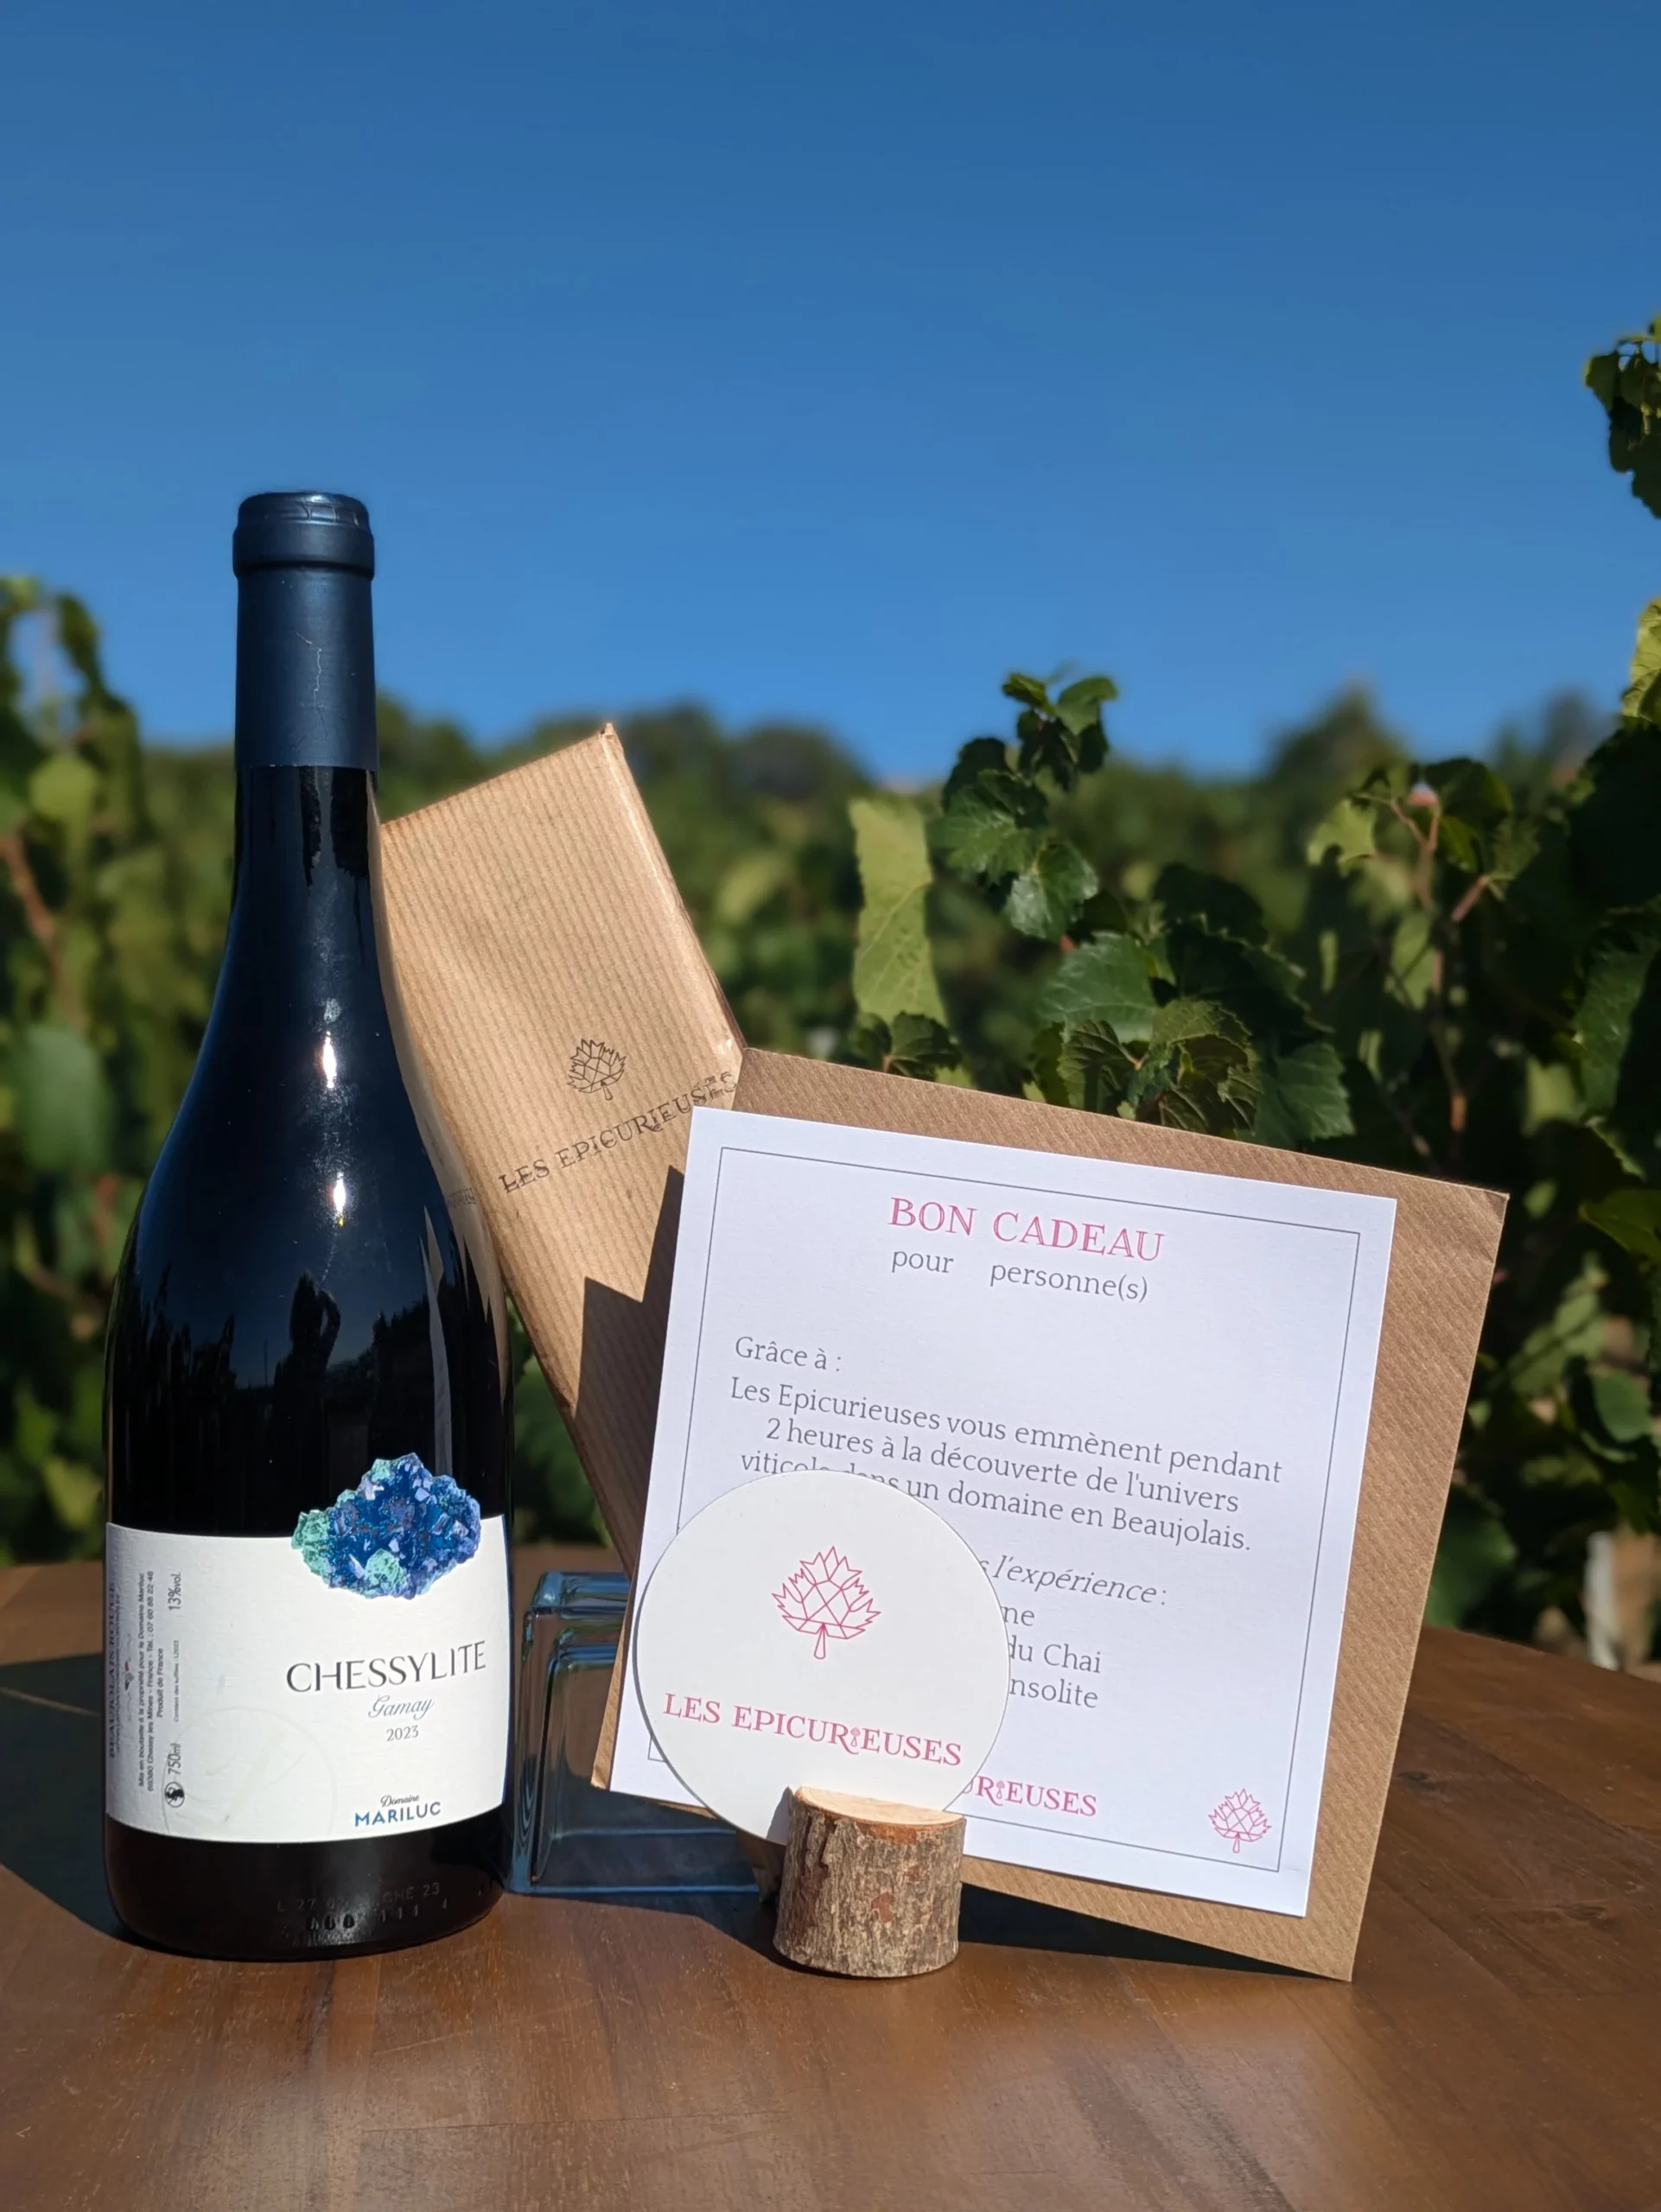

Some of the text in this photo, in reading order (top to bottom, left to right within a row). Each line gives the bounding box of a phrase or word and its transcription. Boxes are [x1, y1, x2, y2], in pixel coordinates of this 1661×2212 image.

[498, 1159, 550, 1194] LES
[888, 1197, 1165, 1262] BON CADEAU
[891, 1249, 1148, 1304] pour personne(s)
[735, 1336, 808, 1366] Grâce
[814, 1348, 827, 1370] à
[731, 1376, 1282, 1484] Les Epicurieuses vous emmènent pendant
[767, 1418, 1239, 1513] 2 heures à la découverte de l'univers
[906, 1479, 939, 1500] un
[948, 1480, 1063, 1520] domaine
[1071, 1508, 1103, 1527] en
[1111, 1508, 1251, 1551] Beaujolais.
[992, 1555, 1157, 1604] l'expérience
[147, 1622, 154, 1632] 07
[286, 1640, 486, 1693] CHESSYLITE
[1044, 1643, 1101, 1674] Chai
[157, 1677, 162, 1688] de
[1009, 1678, 1098, 1708] nsolite
[368, 1694, 435, 1720] Gamay
[386, 1725, 419, 1742] 2023
[664, 1693, 962, 1766] LES EPICURIEUSES
[168, 1743, 181, 1776] 750ml
[354, 1802, 442, 1827] MARILUC
[380, 1795, 420, 1808] Domaine
